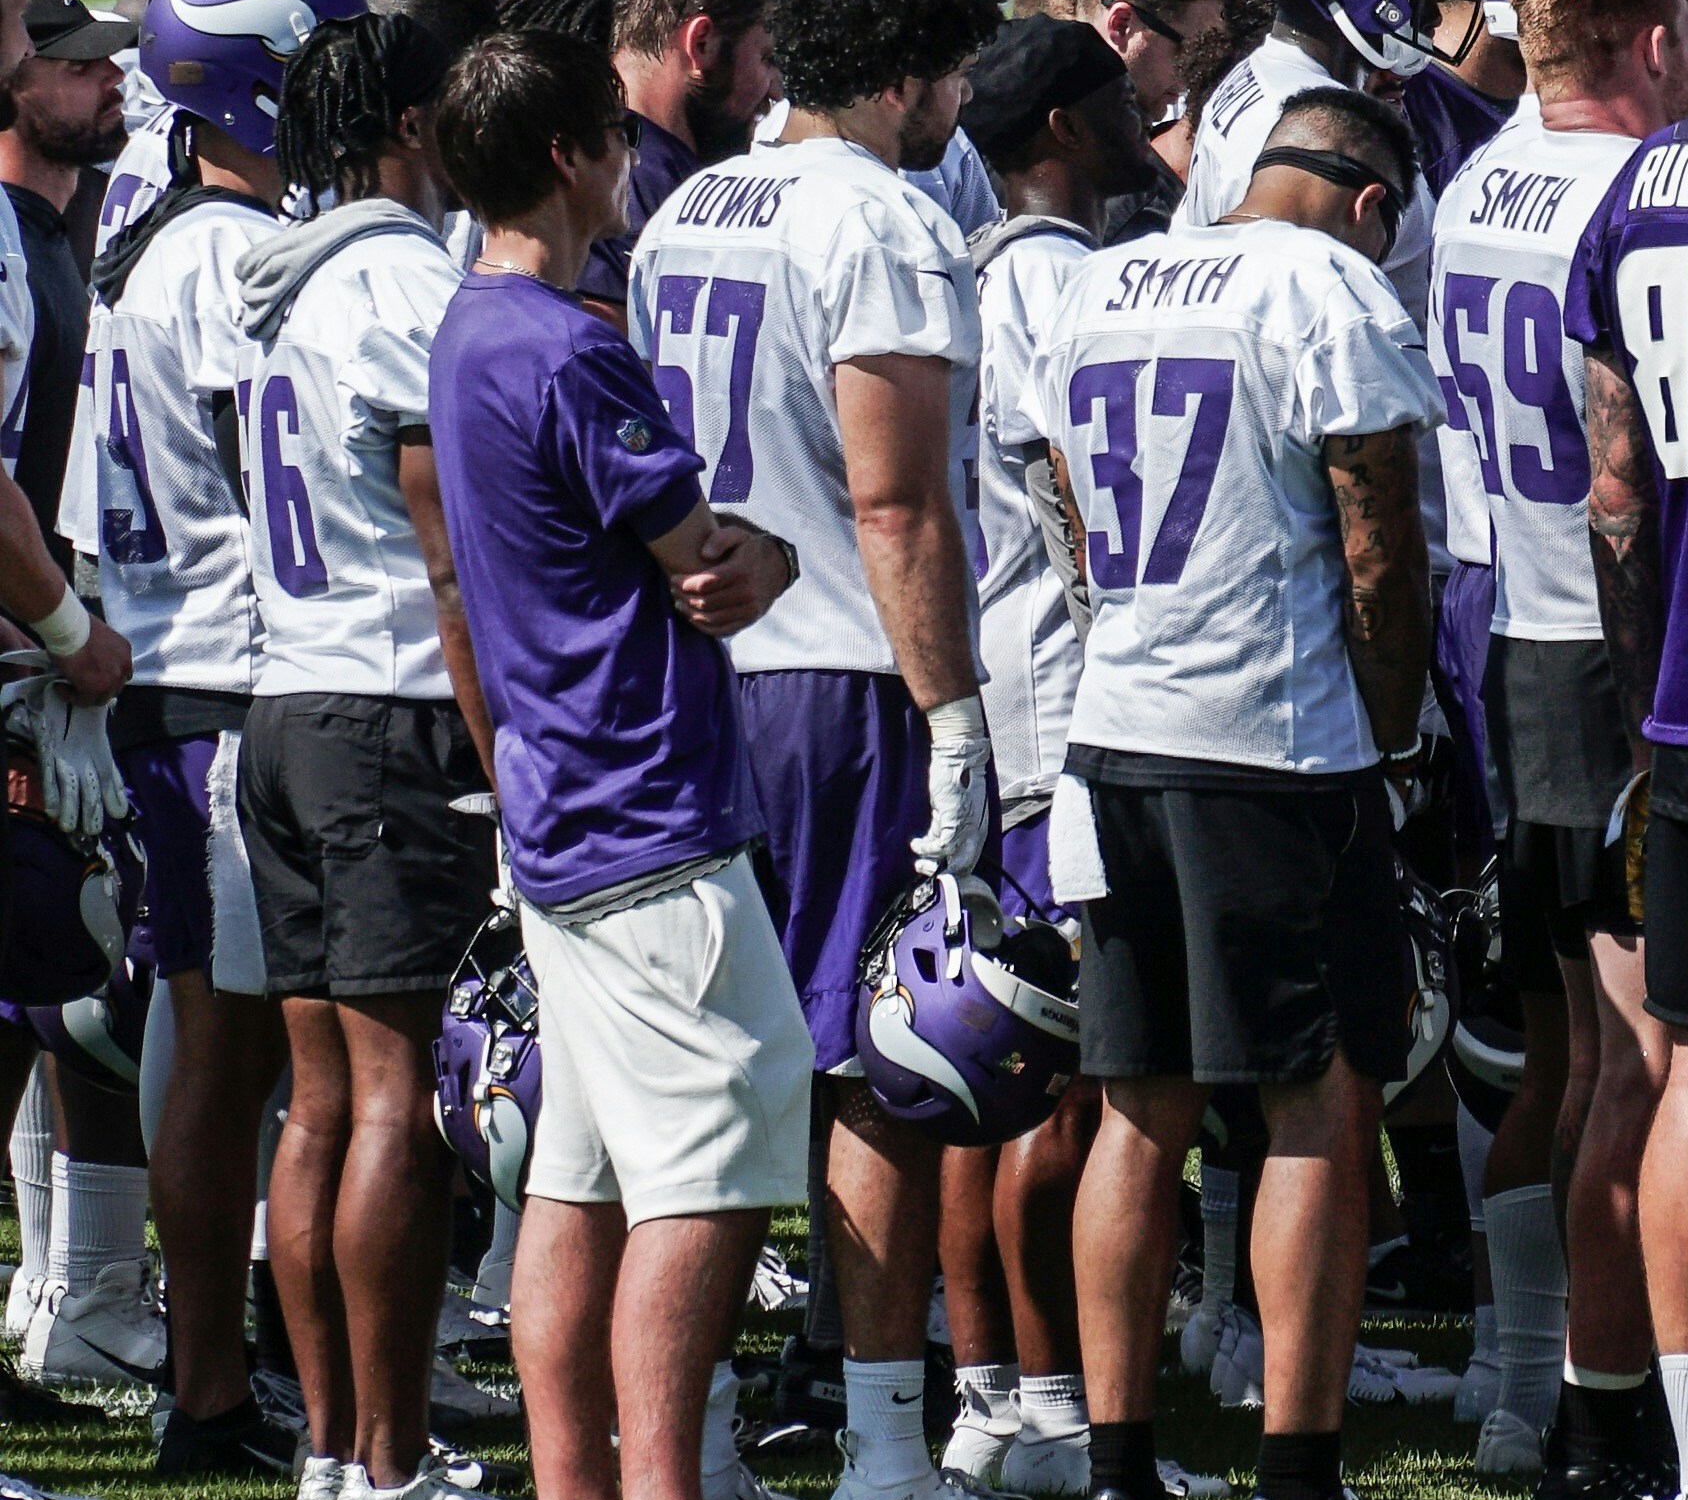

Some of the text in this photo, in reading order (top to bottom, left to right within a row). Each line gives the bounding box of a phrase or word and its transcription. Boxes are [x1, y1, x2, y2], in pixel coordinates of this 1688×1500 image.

[676, 173, 801, 229] DOWNS
[1469, 167, 1577, 234] SMITH
[1105, 253, 1245, 313] SMITH
[653, 274, 767, 505] 57
[1437, 271, 1592, 505] 59
[1068, 356, 1236, 591] 37
